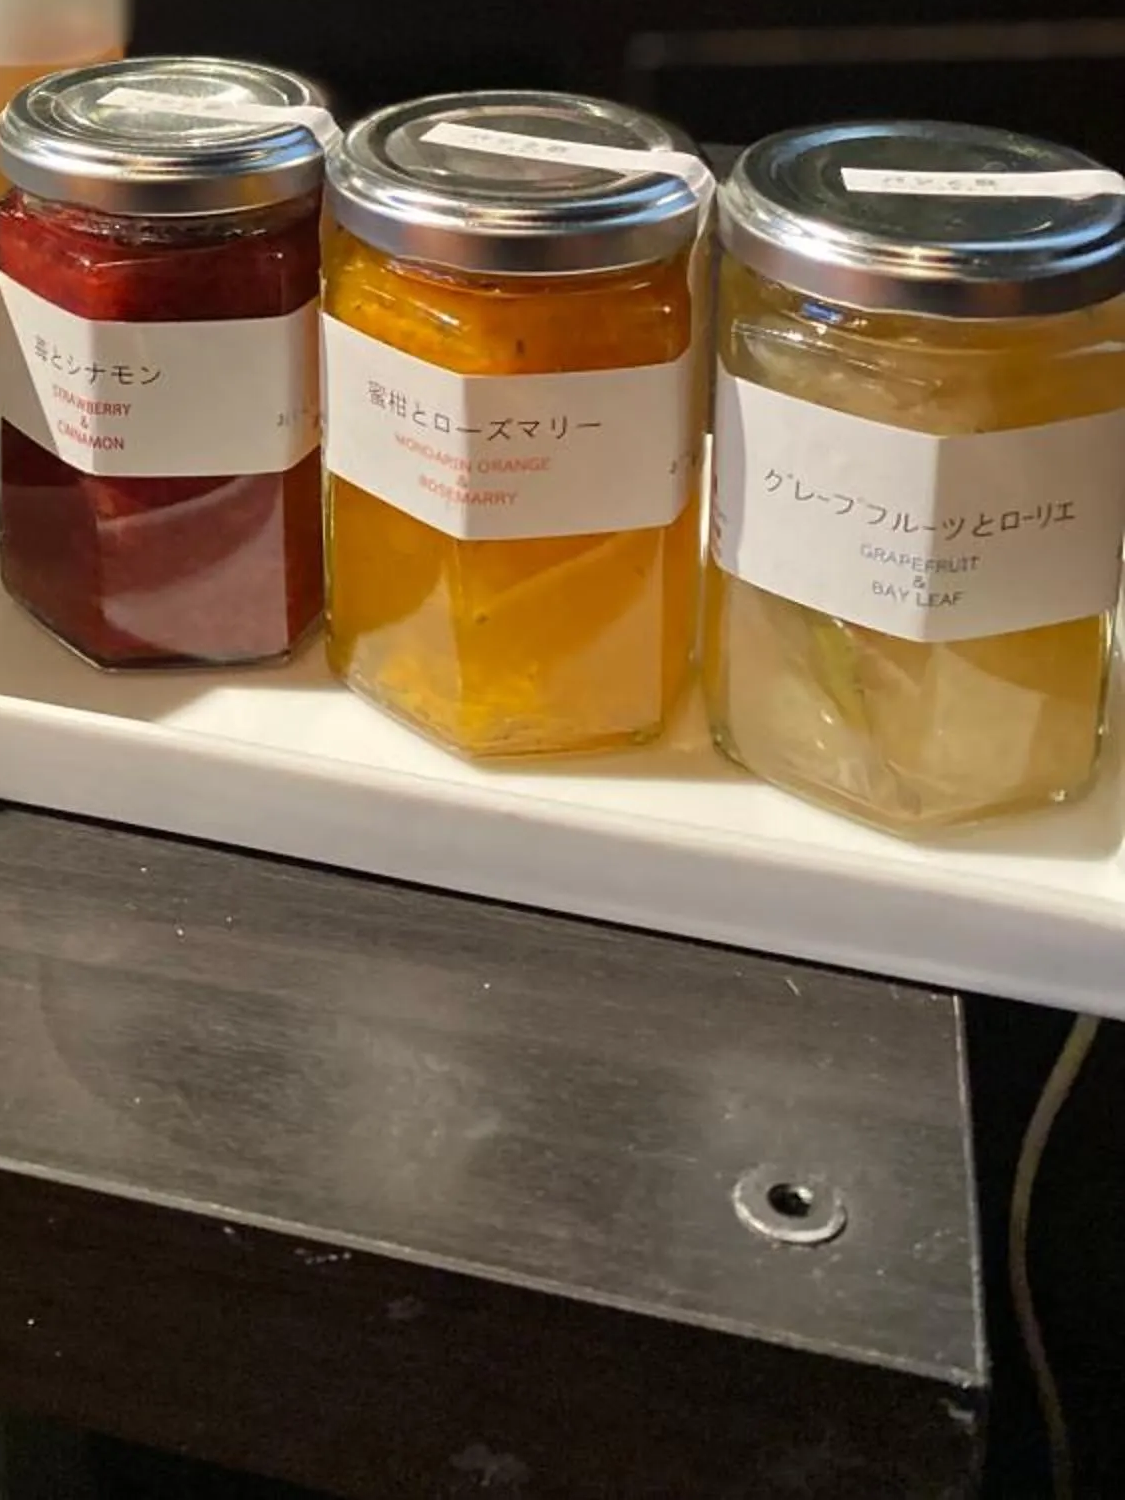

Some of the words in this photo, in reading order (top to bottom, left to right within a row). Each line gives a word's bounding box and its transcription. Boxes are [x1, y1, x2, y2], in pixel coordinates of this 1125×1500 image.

[51, 384, 132, 416] STRAWBERRY
[364, 379, 602, 441] 蜜柑とローズマリー
[57, 419, 125, 450] CINNAMON
[477, 455, 551, 474] ORANGE
[764, 468, 1077, 540] グレープフルーツとローリエ
[859, 542, 981, 573] GRAPEFRUIT
[872, 580, 911, 602] BAY
[916, 590, 965, 607] LEAF
[912, 575, 926, 589] &
